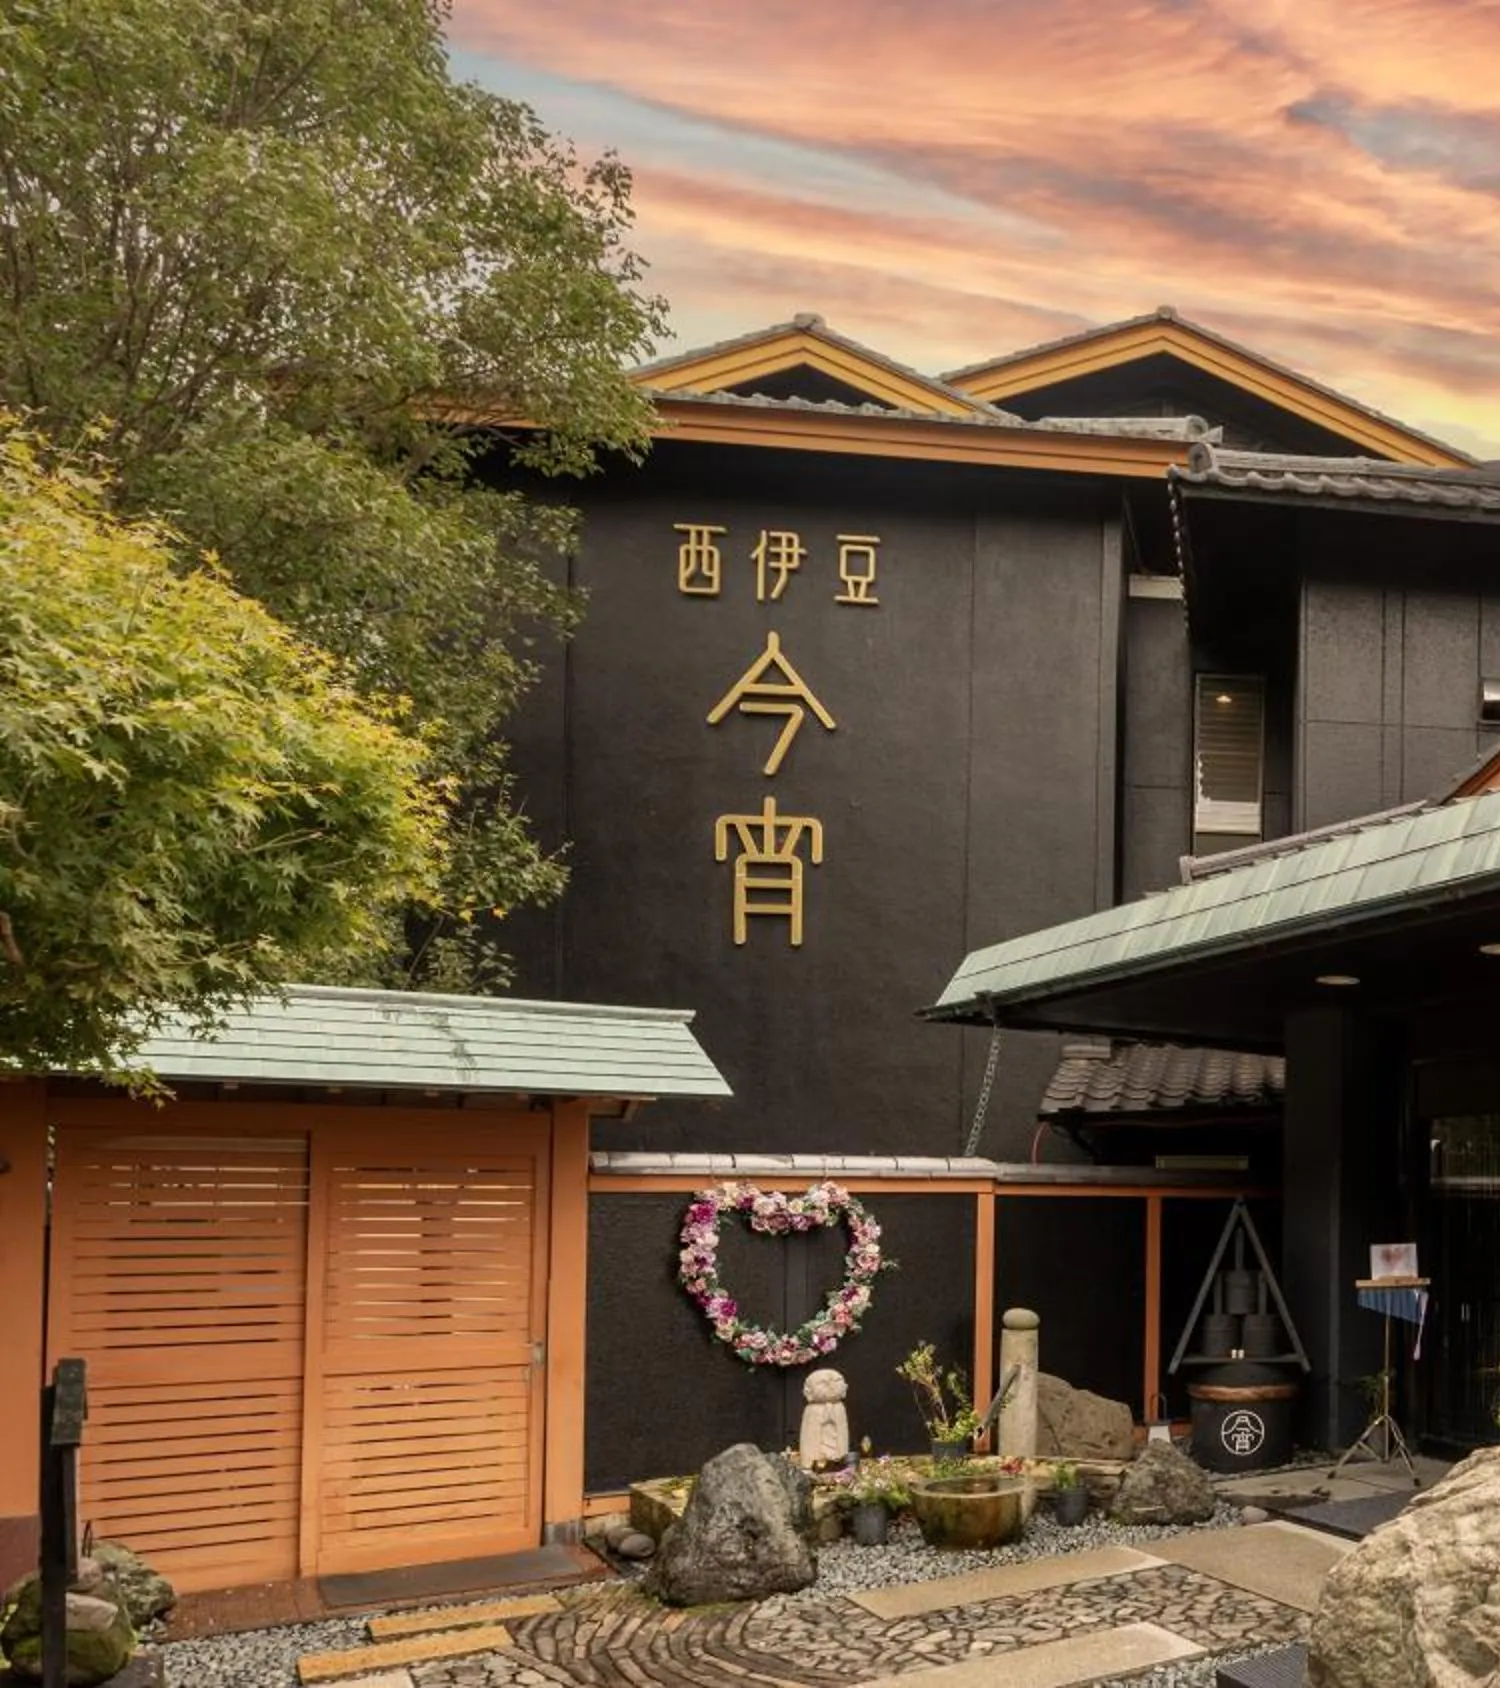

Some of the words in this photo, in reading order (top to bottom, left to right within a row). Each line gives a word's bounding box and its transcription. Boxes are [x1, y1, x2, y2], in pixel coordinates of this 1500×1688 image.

[673, 523, 881, 606] 西伊豆
[706, 631, 837, 946] 今宵
